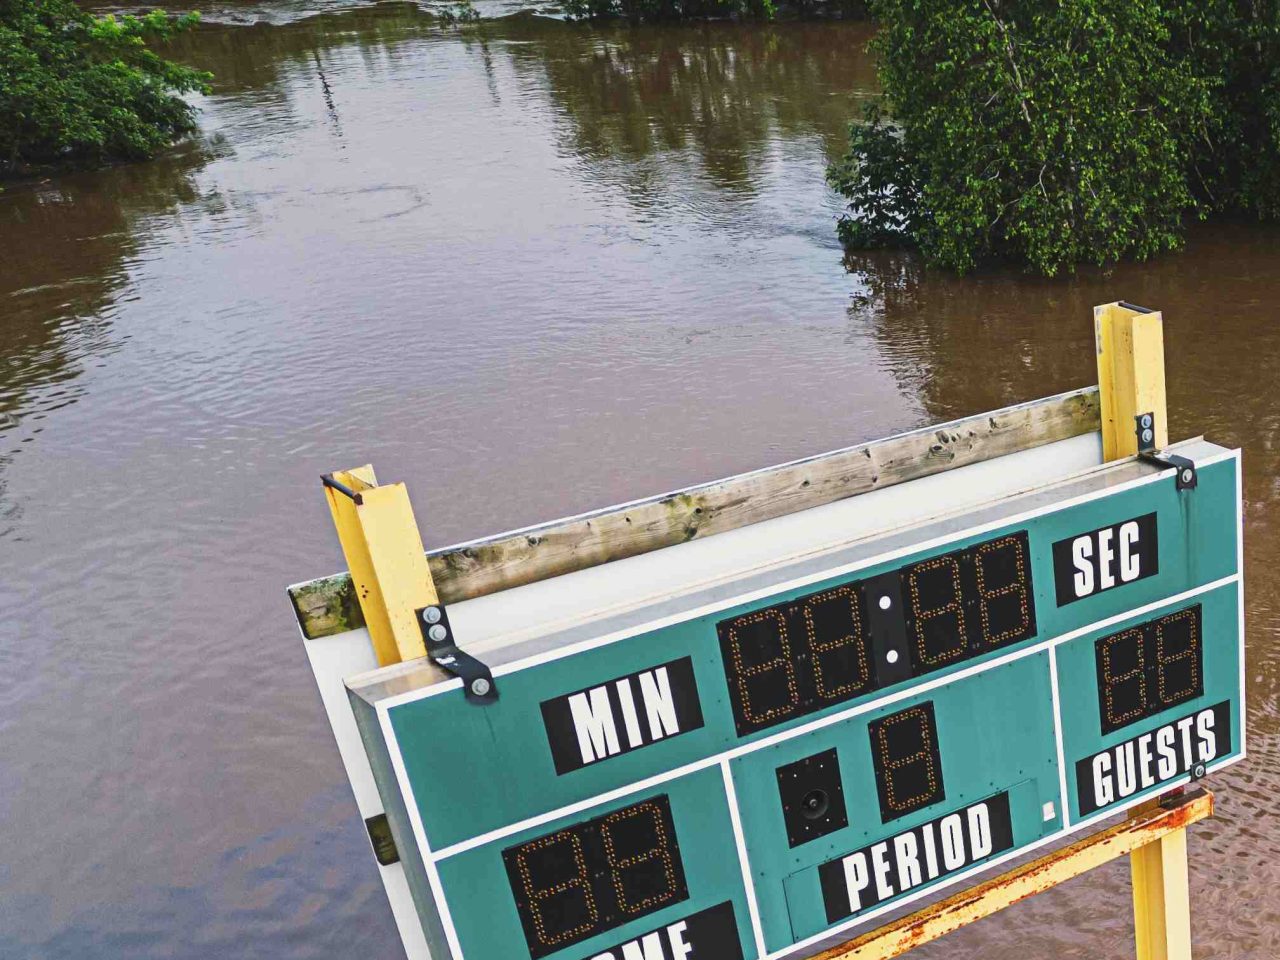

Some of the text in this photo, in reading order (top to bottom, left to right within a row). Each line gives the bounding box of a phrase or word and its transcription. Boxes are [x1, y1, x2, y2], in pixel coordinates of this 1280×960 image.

[1072, 521, 1140, 598] SEC
[567, 666, 680, 764] MIN
[1092, 709, 1217, 807] GUESTS
[842, 802, 993, 913] PERIOD
